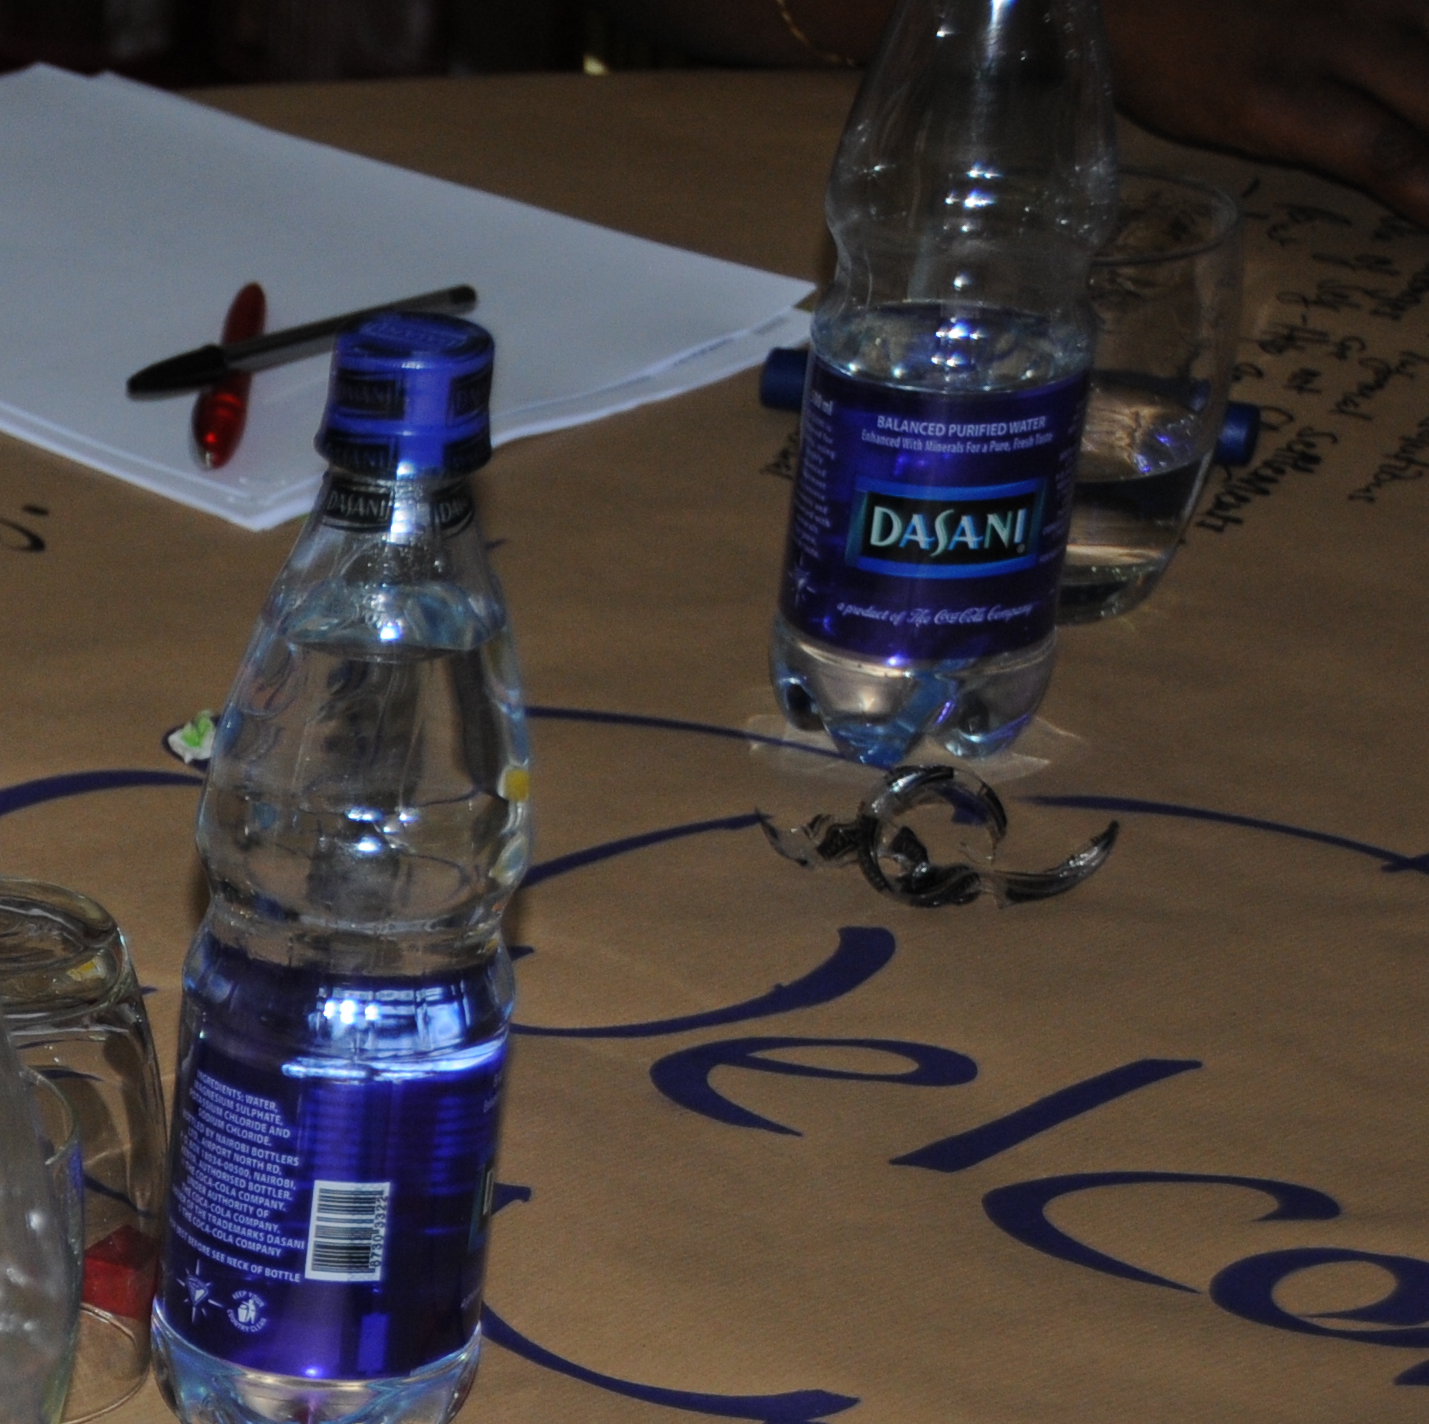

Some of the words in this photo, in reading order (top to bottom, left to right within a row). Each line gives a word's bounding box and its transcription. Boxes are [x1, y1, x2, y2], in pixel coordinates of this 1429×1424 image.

[876, 415, 946, 437] BALANCED
[948, 421, 1007, 438] PURIFIED
[1008, 415, 1047, 435] WATER
[869, 505, 1029, 557] DASANI
[269, 1125, 291, 1138] AND
[251, 1147, 299, 1167] BOTTLERS
[266, 1234, 305, 1250] DASANI
[264, 1268, 301, 1283] BOTTLE
